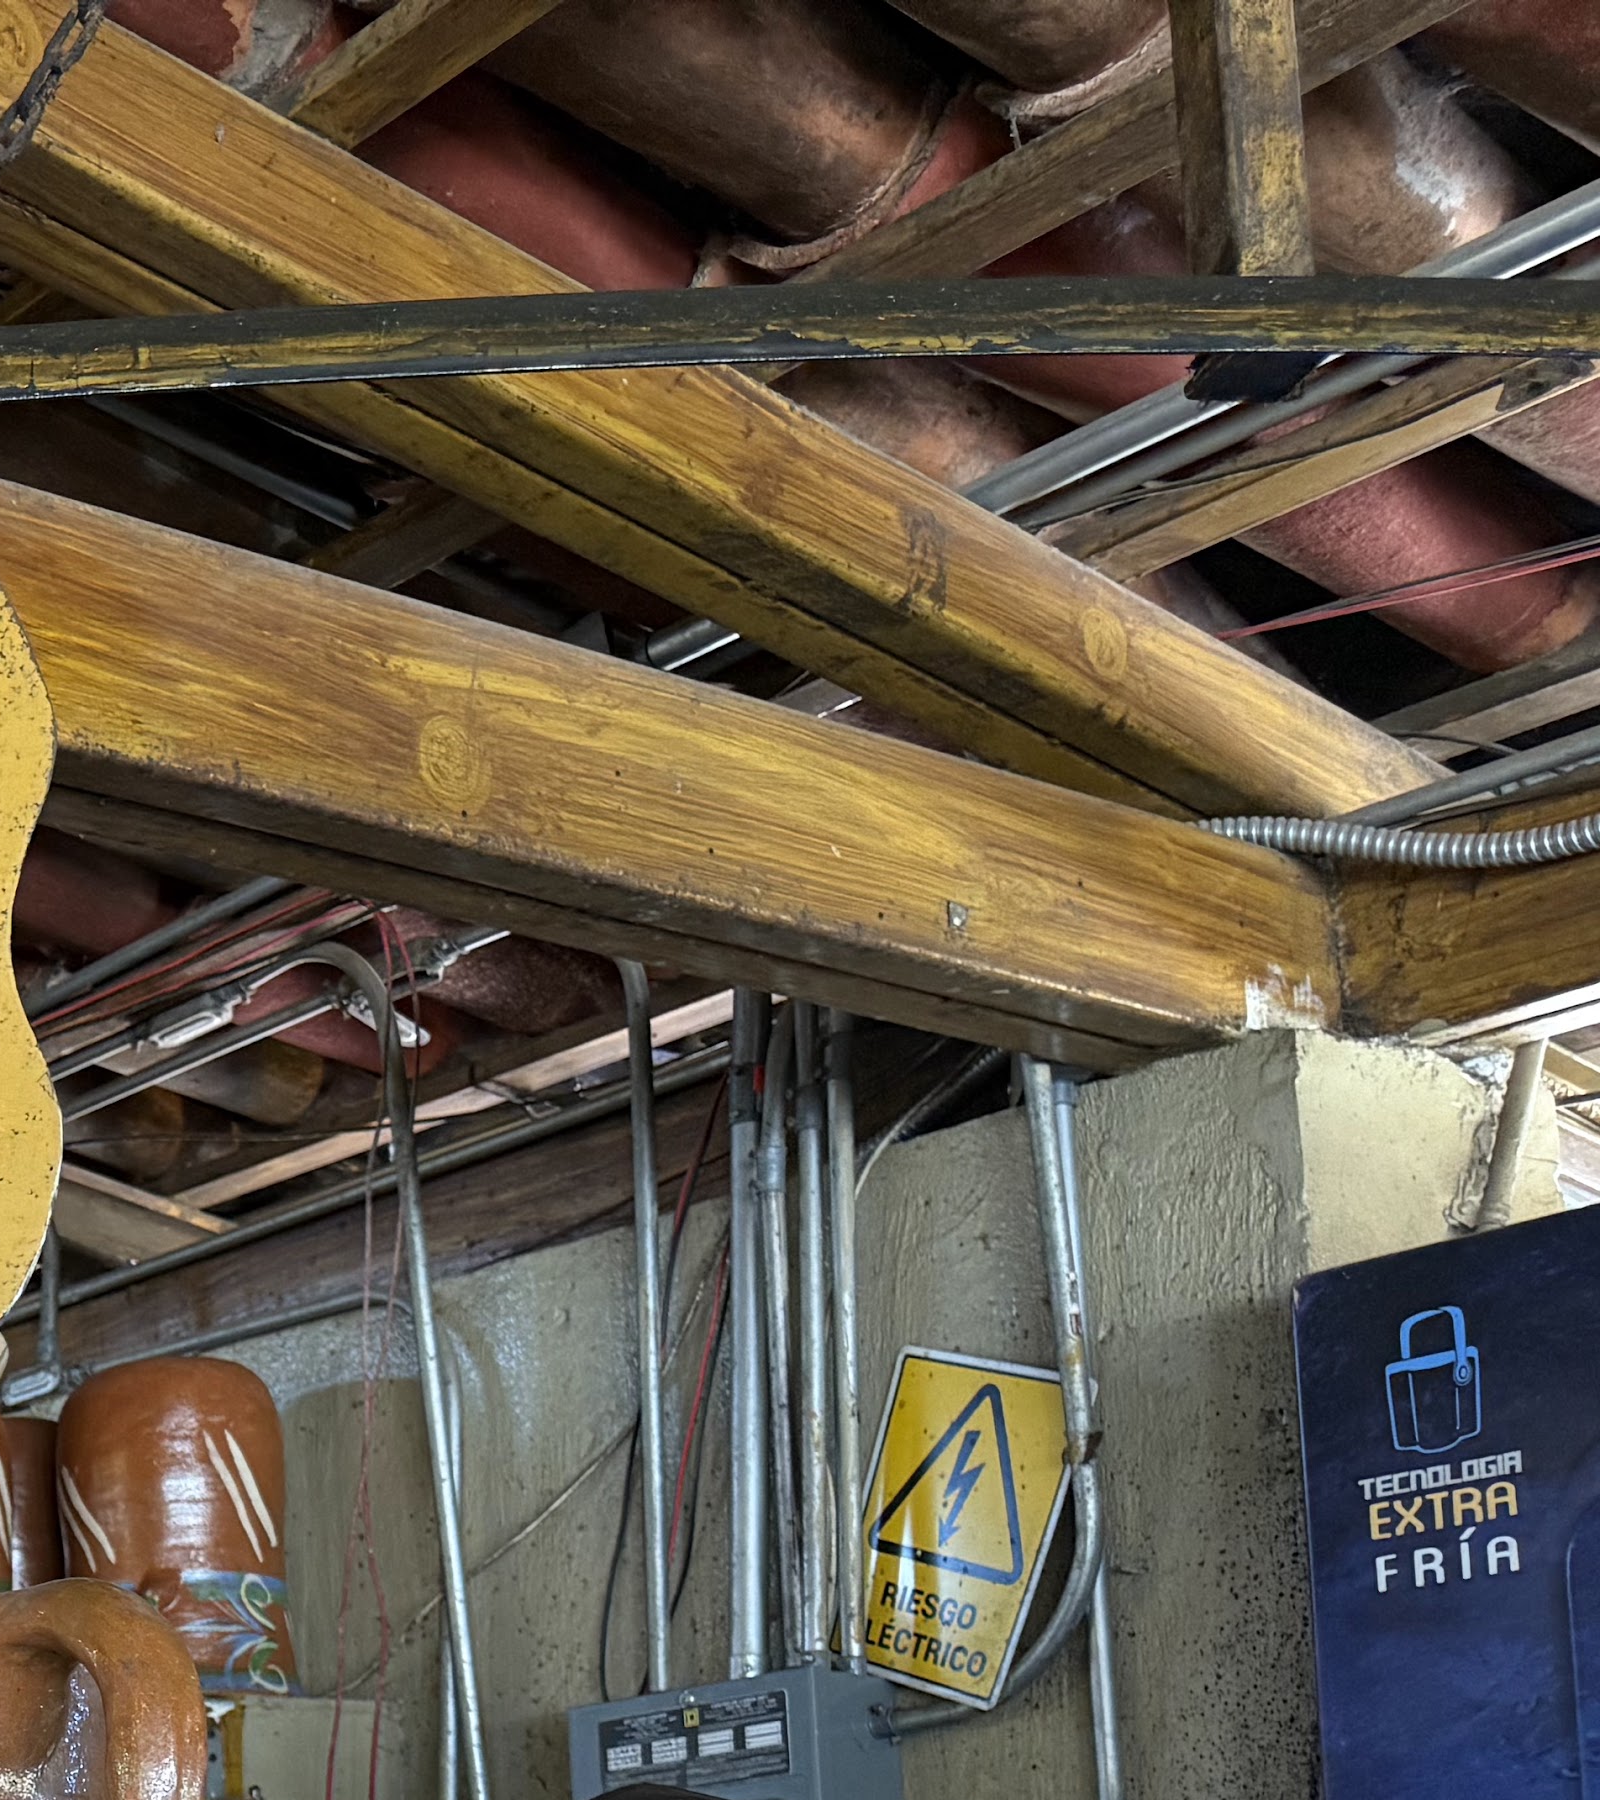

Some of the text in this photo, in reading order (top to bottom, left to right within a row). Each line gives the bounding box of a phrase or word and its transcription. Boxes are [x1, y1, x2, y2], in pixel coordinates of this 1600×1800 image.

[1357, 1450, 1523, 1500] TECNOLOGIA
[1368, 1481, 1519, 1541] EXTRA
[1374, 1528, 1521, 1593] FRÍA
[880, 1581, 978, 1630] RIESGO
[865, 1618, 988, 1678] LÉCTRICO
